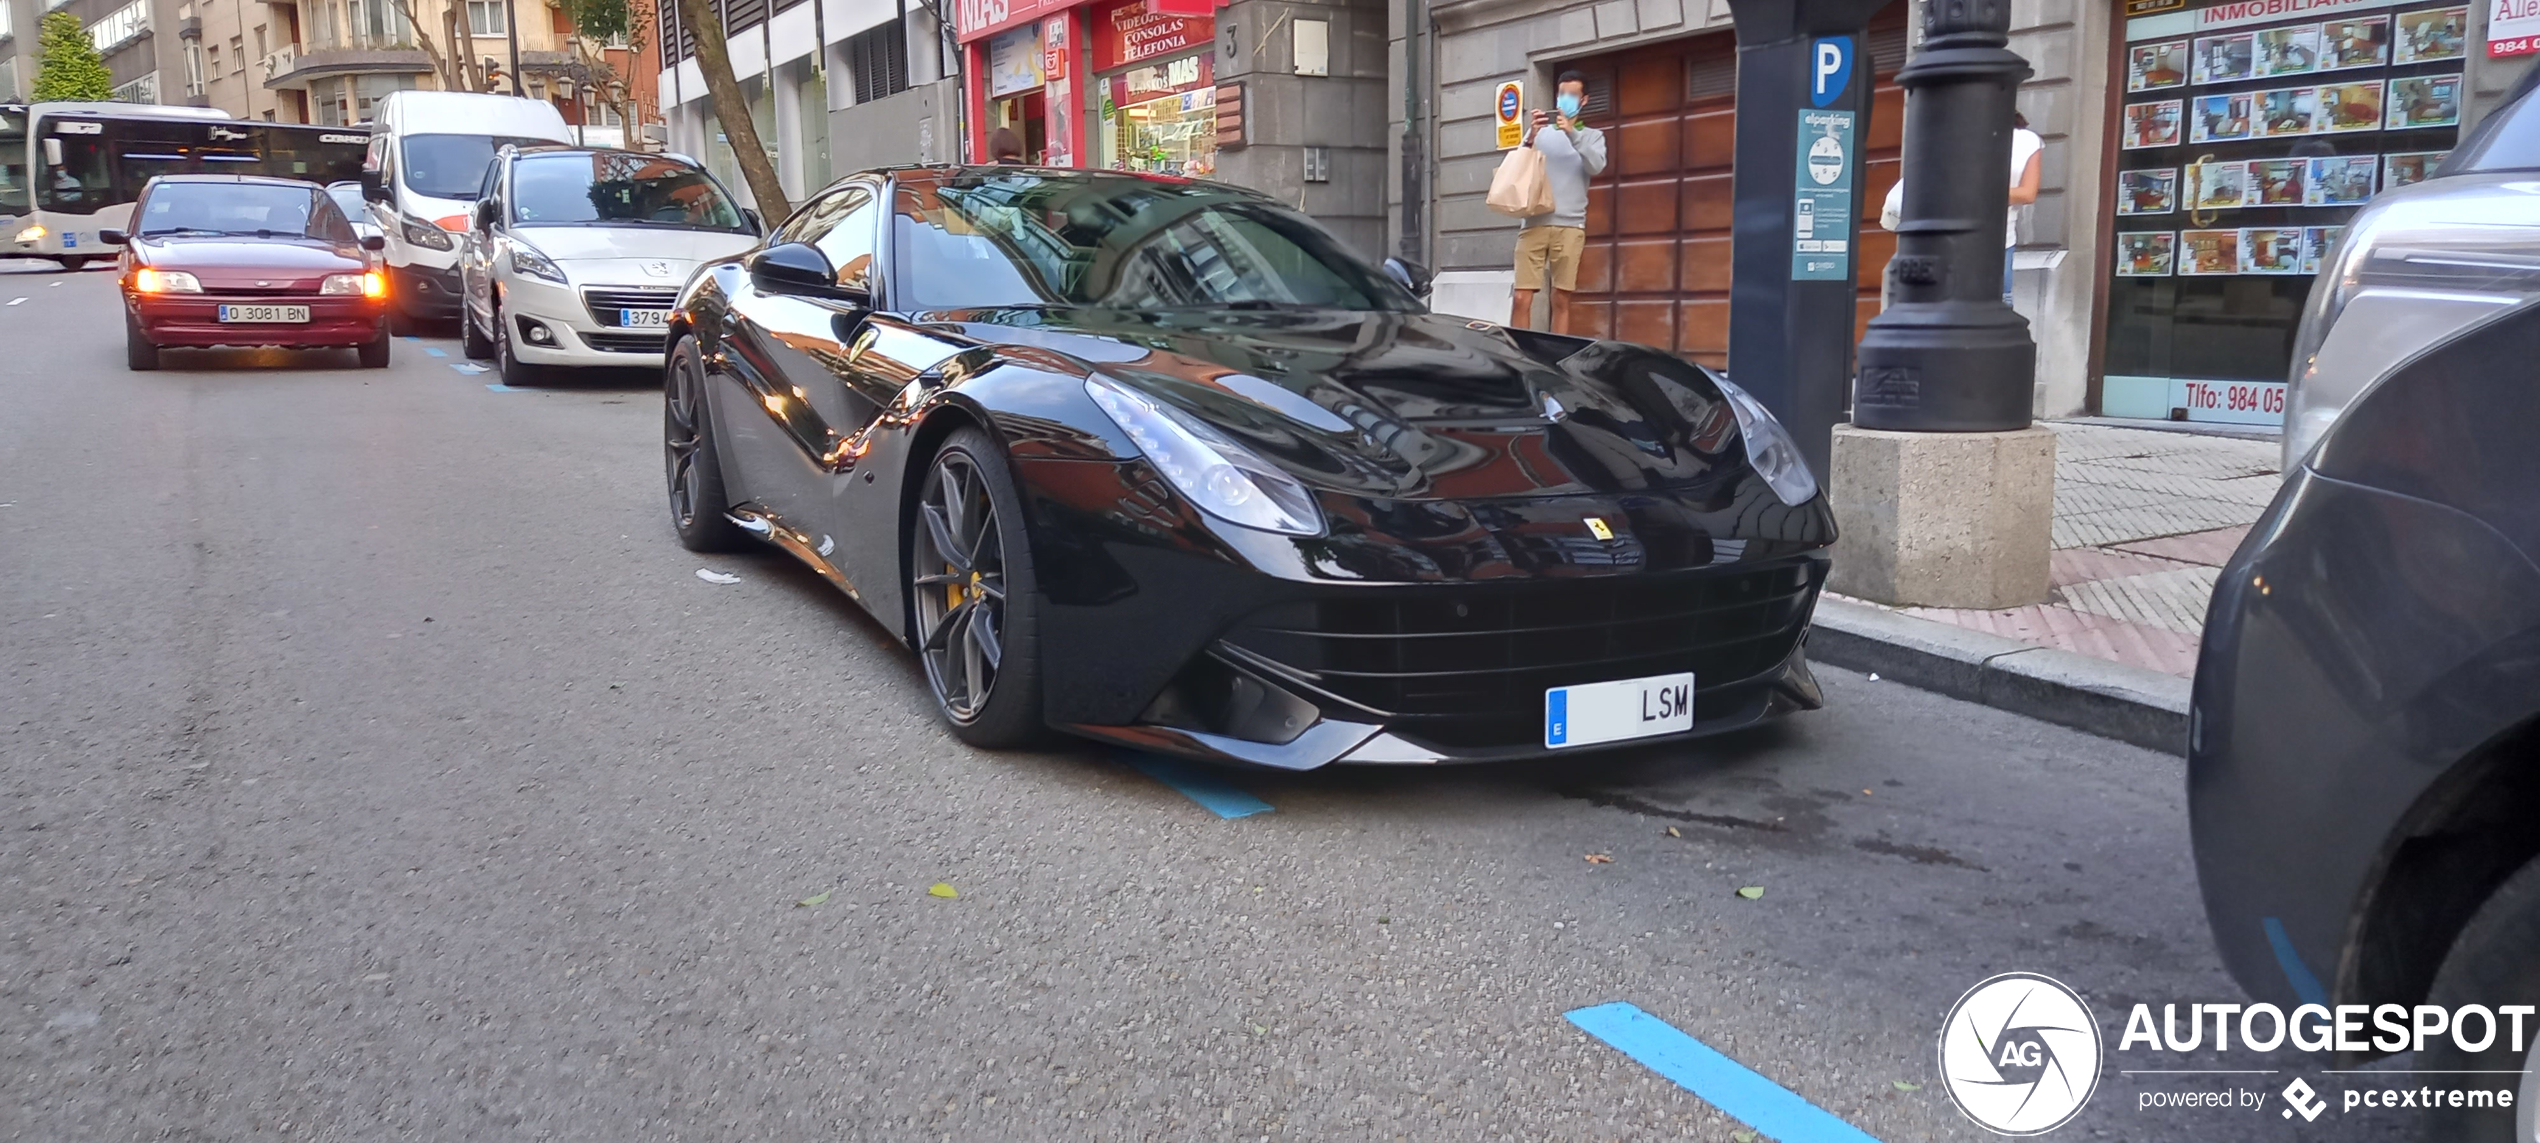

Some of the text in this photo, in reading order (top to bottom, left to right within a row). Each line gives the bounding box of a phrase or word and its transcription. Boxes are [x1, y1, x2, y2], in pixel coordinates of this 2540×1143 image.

[960, 0, 1009, 35] MAS
[2494, 0, 2540, 21] Alle
[1124, 19, 1184, 45] CONSOLAS
[1226, 23, 1237, 59] 3
[1123, 35, 1187, 61] TELEFONIA
[2493, 40, 2528, 54] 984
[1168, 56, 1198, 87] MAS
[1816, 43, 1842, 94] P
[245, 307, 280, 320] 3081
[287, 307, 305, 320] BN
[2228, 386, 2257, 412] 984
[2263, 388, 2284, 413] 05
[1643, 684, 1688, 722] LSM
[1553, 722, 1562, 736] E
